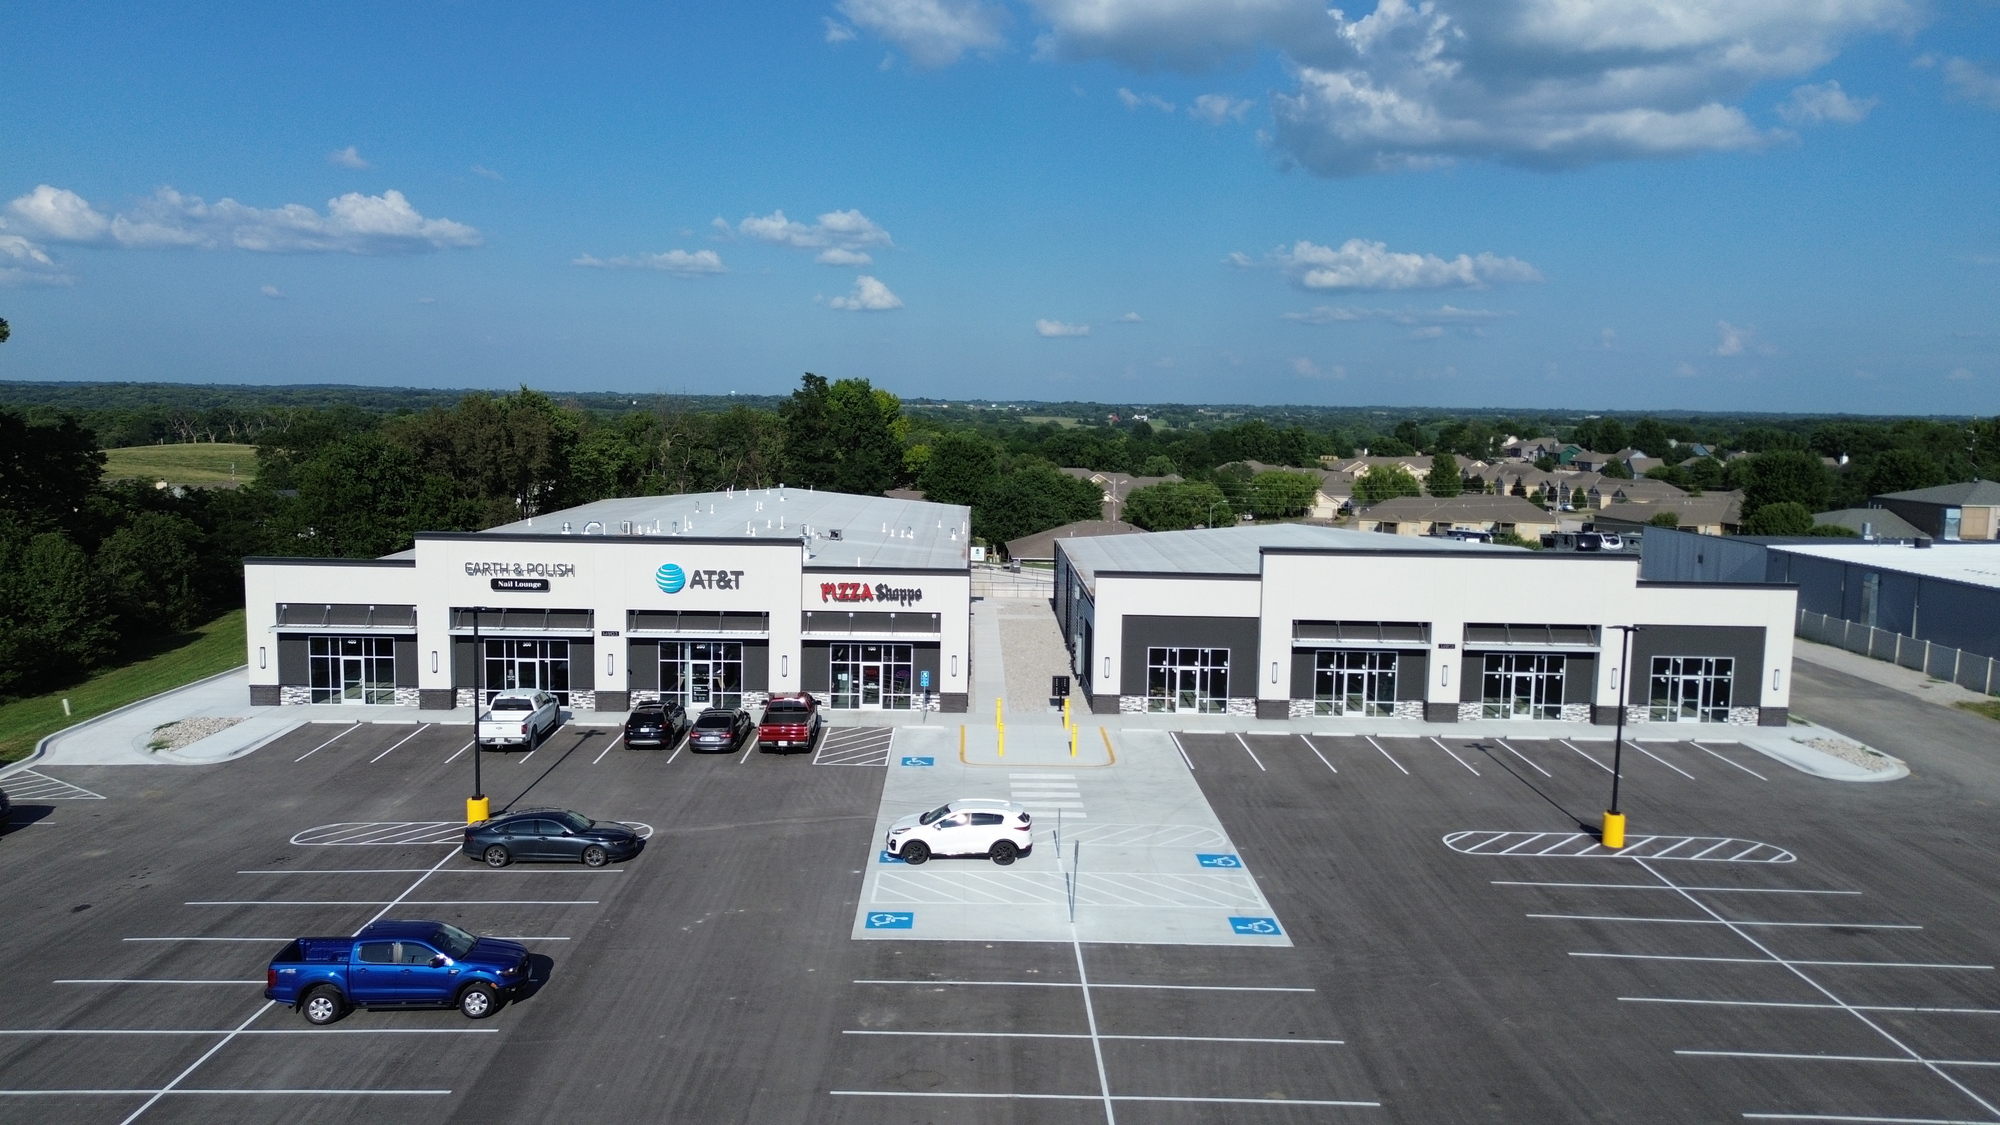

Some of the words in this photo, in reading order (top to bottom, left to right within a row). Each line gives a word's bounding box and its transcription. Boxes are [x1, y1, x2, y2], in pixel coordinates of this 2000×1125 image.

[464, 562, 510, 576] EARTH
[513, 562, 524, 576] &
[526, 563, 575, 577] POLISH
[498, 580, 513, 588] Nail
[514, 581, 542, 589] Lounge
[689, 569, 744, 590] AT&T
[820, 583, 874, 603] PIZZA
[875, 583, 922, 607] Shoppe
